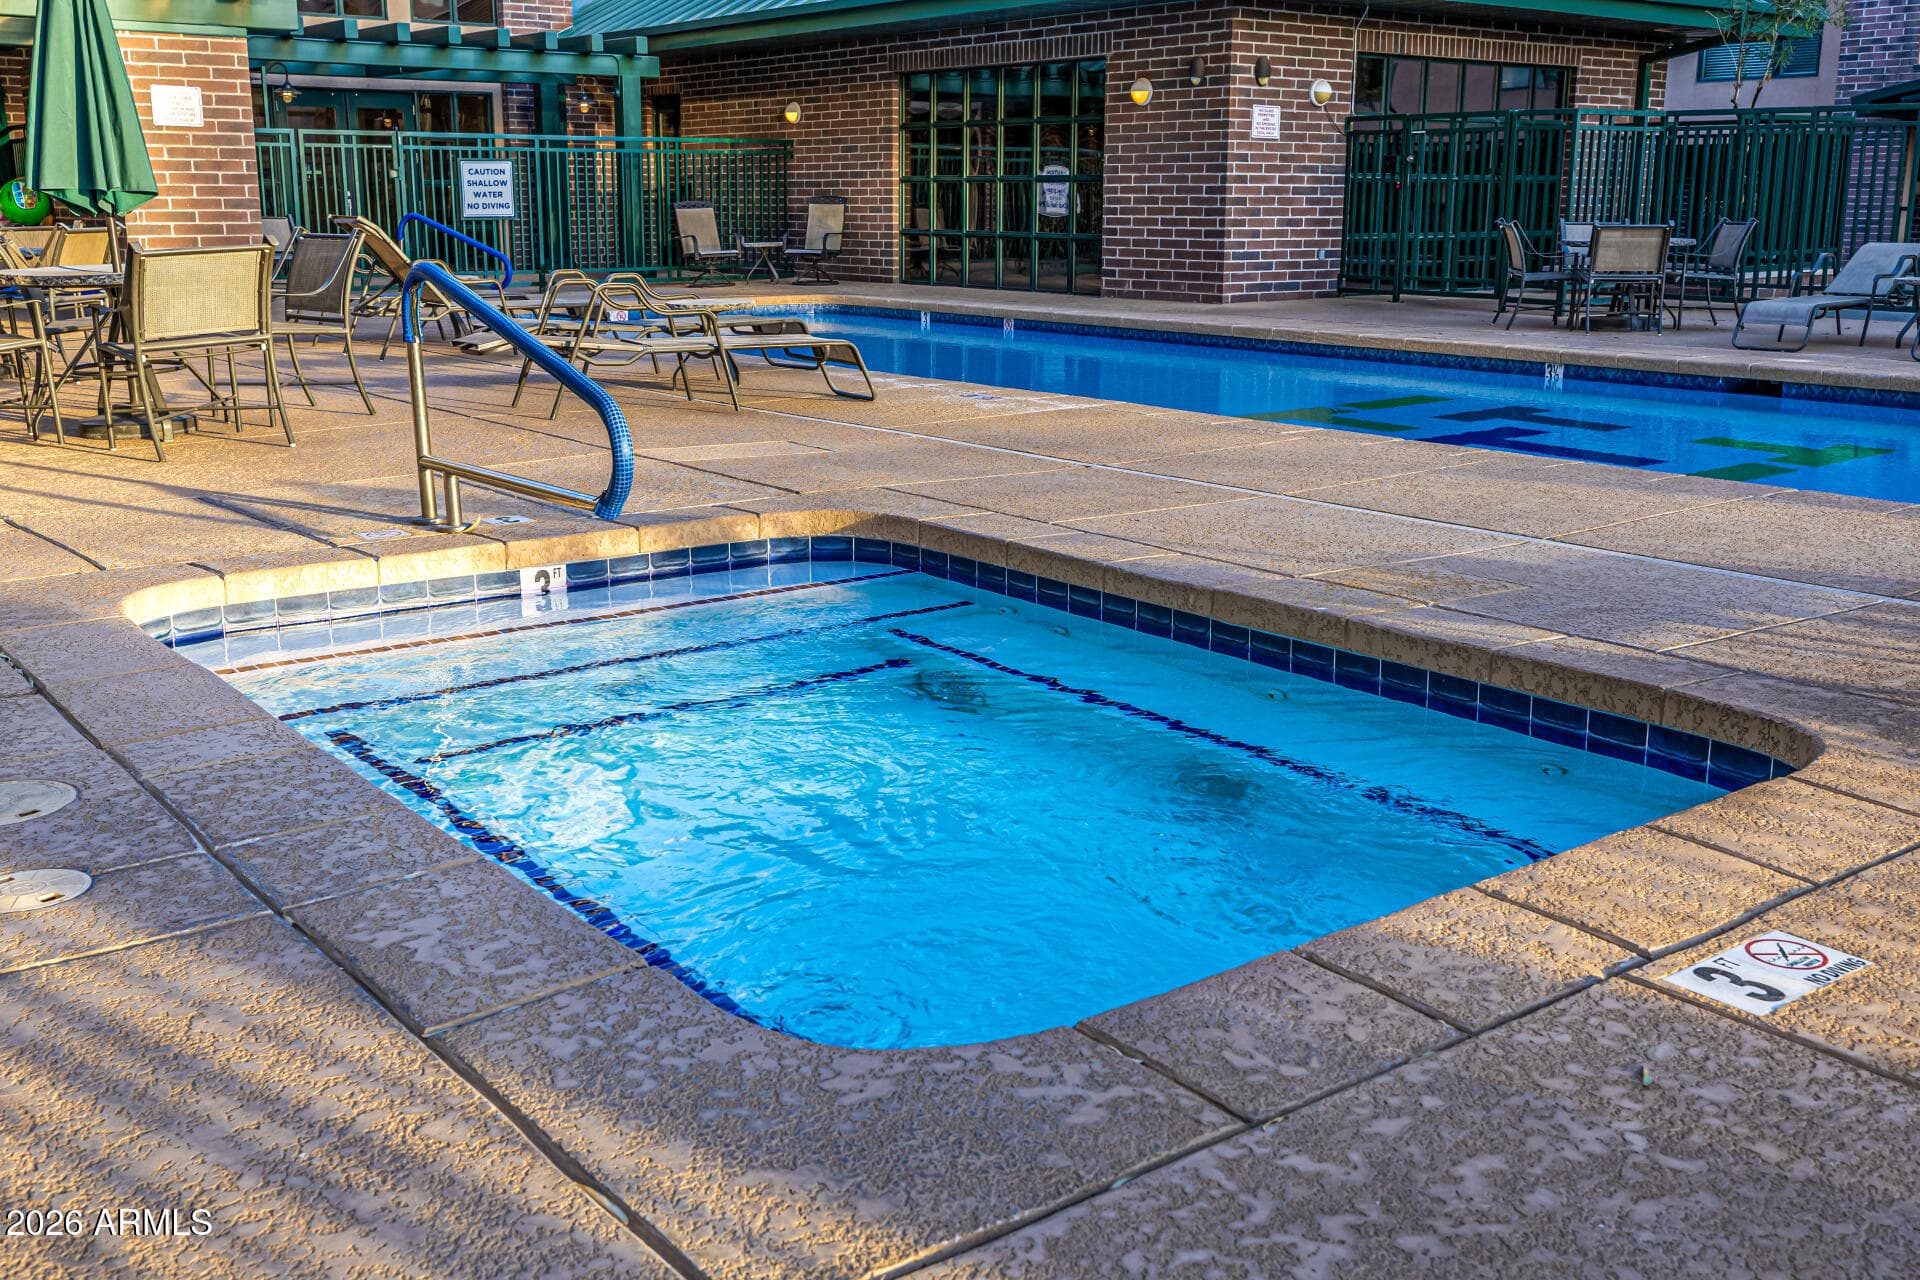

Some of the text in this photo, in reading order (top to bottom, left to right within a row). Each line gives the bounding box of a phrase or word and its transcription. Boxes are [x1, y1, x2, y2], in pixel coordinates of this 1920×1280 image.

[535, 568, 562, 596] 3 FT
[1692, 956, 1786, 1002] 3 FT
[1803, 957, 1867, 986] NO DIVING
